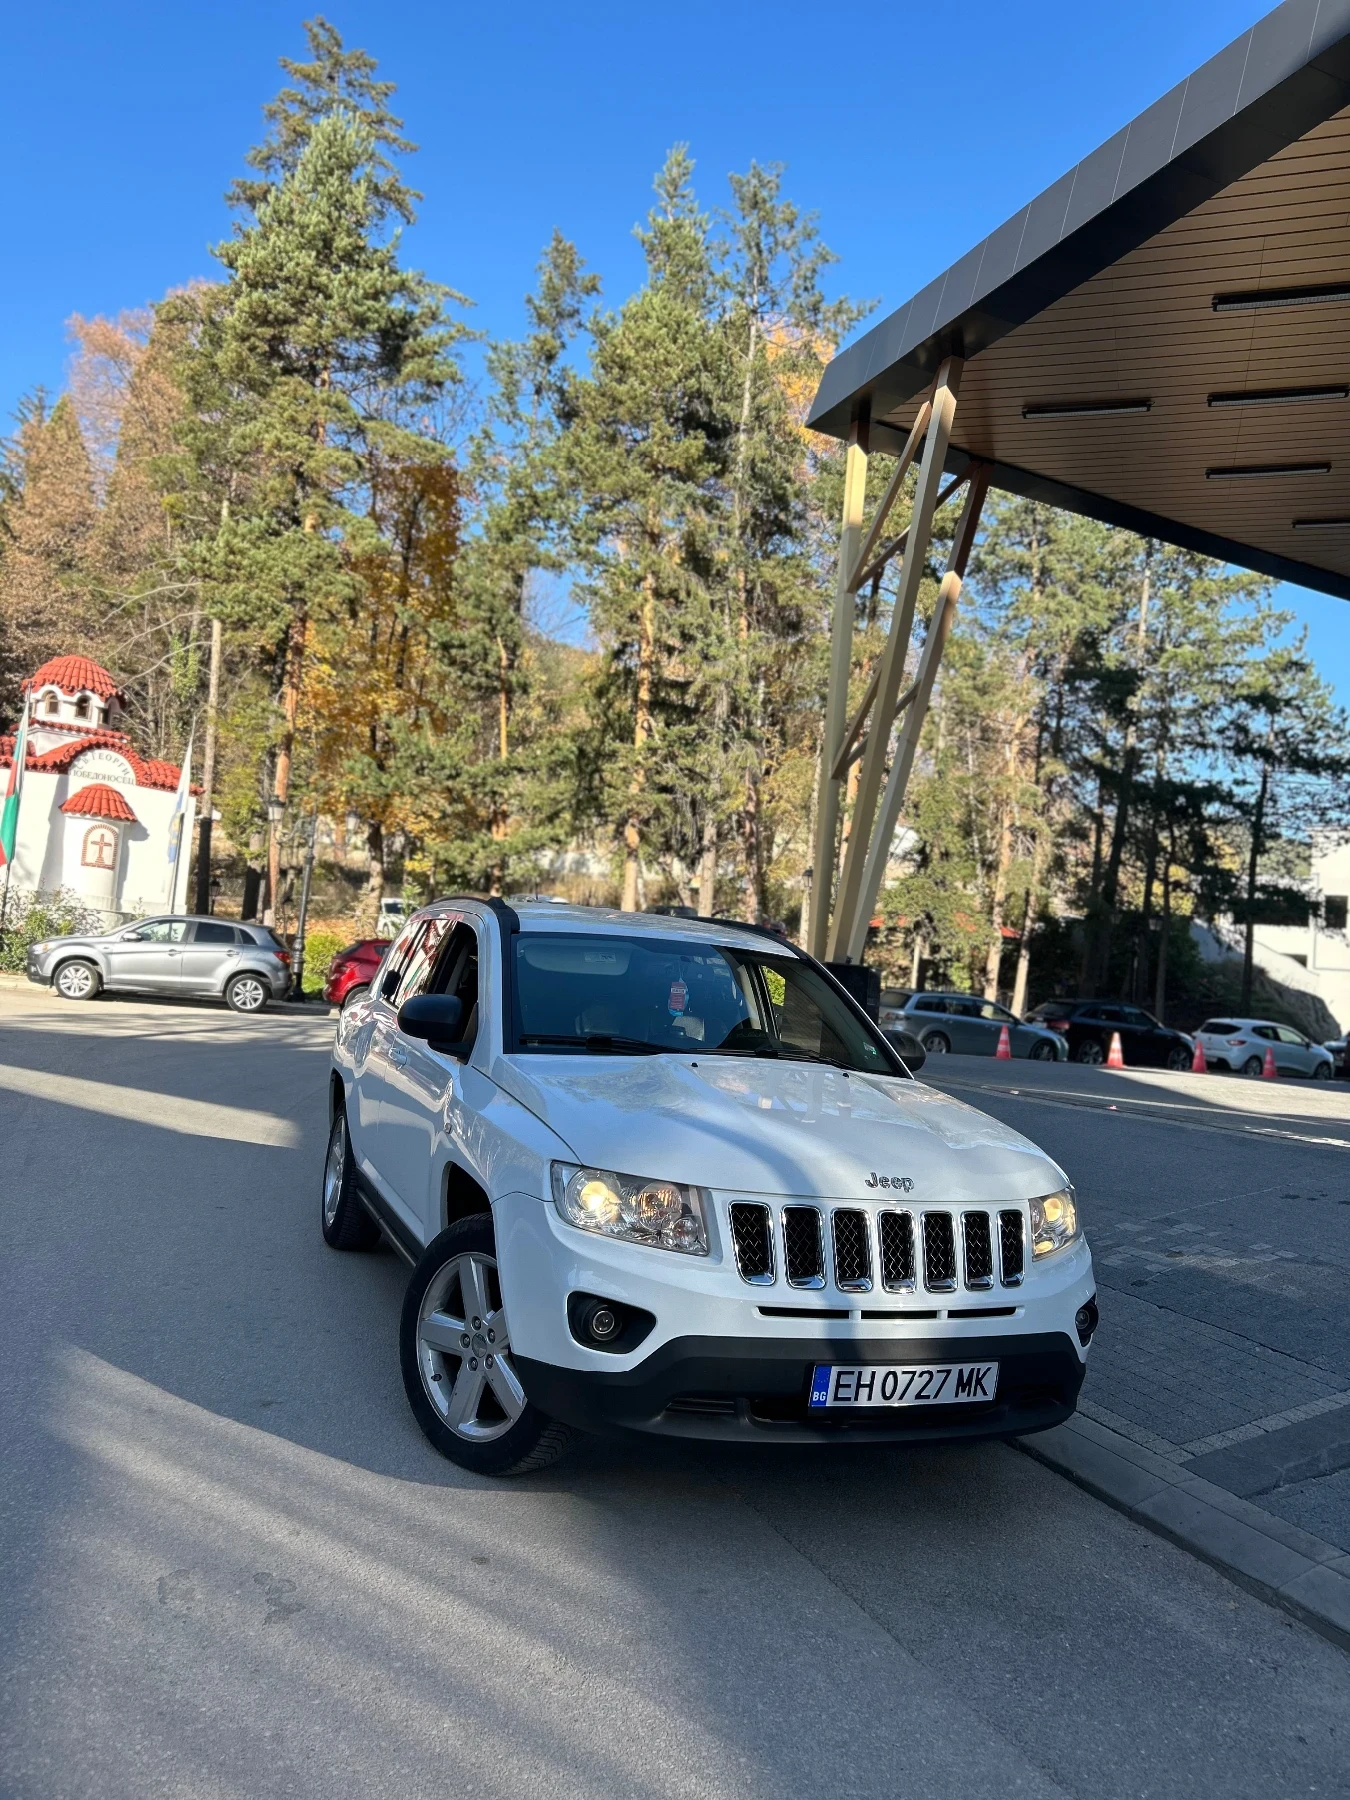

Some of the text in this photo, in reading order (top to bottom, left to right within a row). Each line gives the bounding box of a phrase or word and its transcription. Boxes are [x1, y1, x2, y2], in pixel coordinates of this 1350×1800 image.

[865, 1172, 914, 1193] Jeep
[833, 1366, 993, 1402] EH 0727 MK
[813, 1391, 827, 1402] BG
